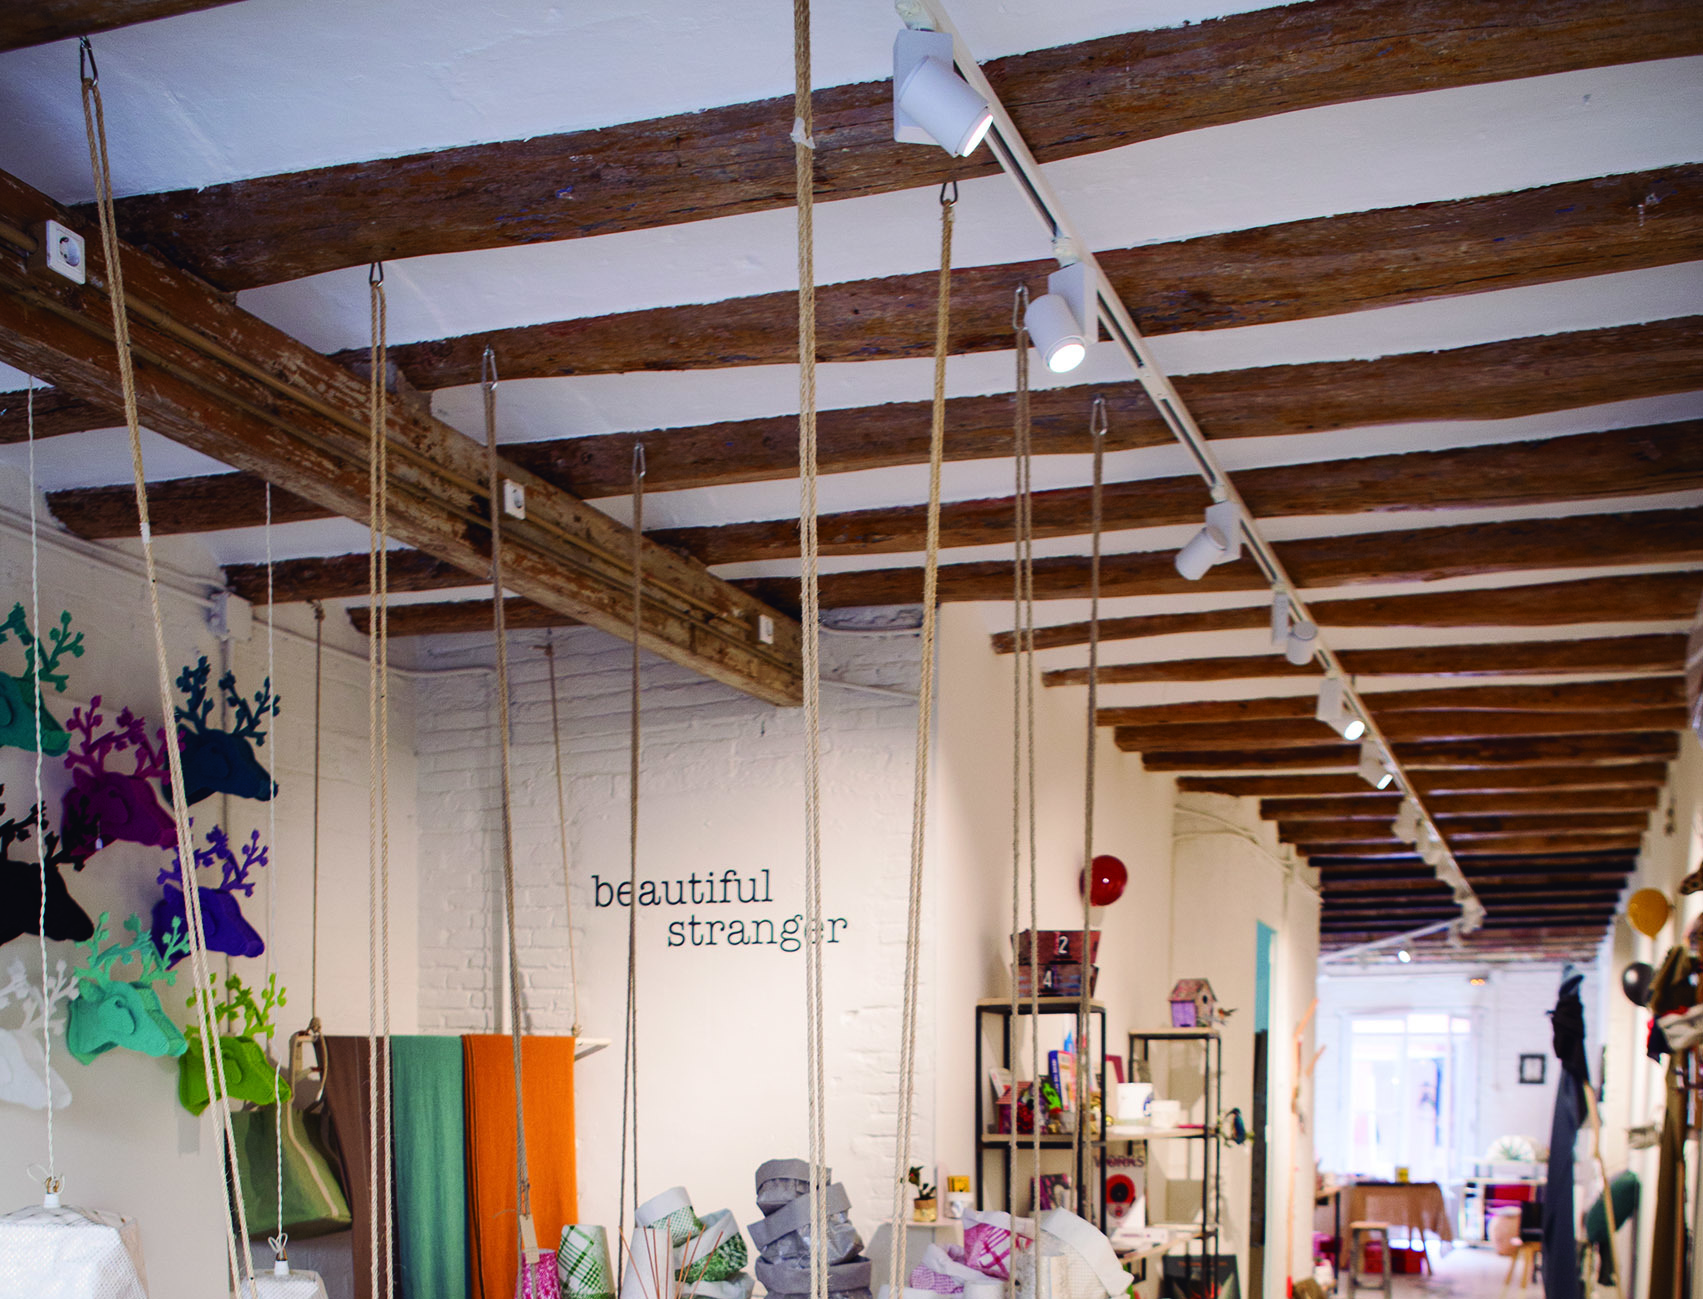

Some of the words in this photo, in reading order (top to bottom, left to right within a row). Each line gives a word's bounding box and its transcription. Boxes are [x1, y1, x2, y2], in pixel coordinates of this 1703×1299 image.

[591, 869, 774, 908] beautiful
[1057, 935, 1070, 955] 2
[1042, 969, 1053, 988] 4
